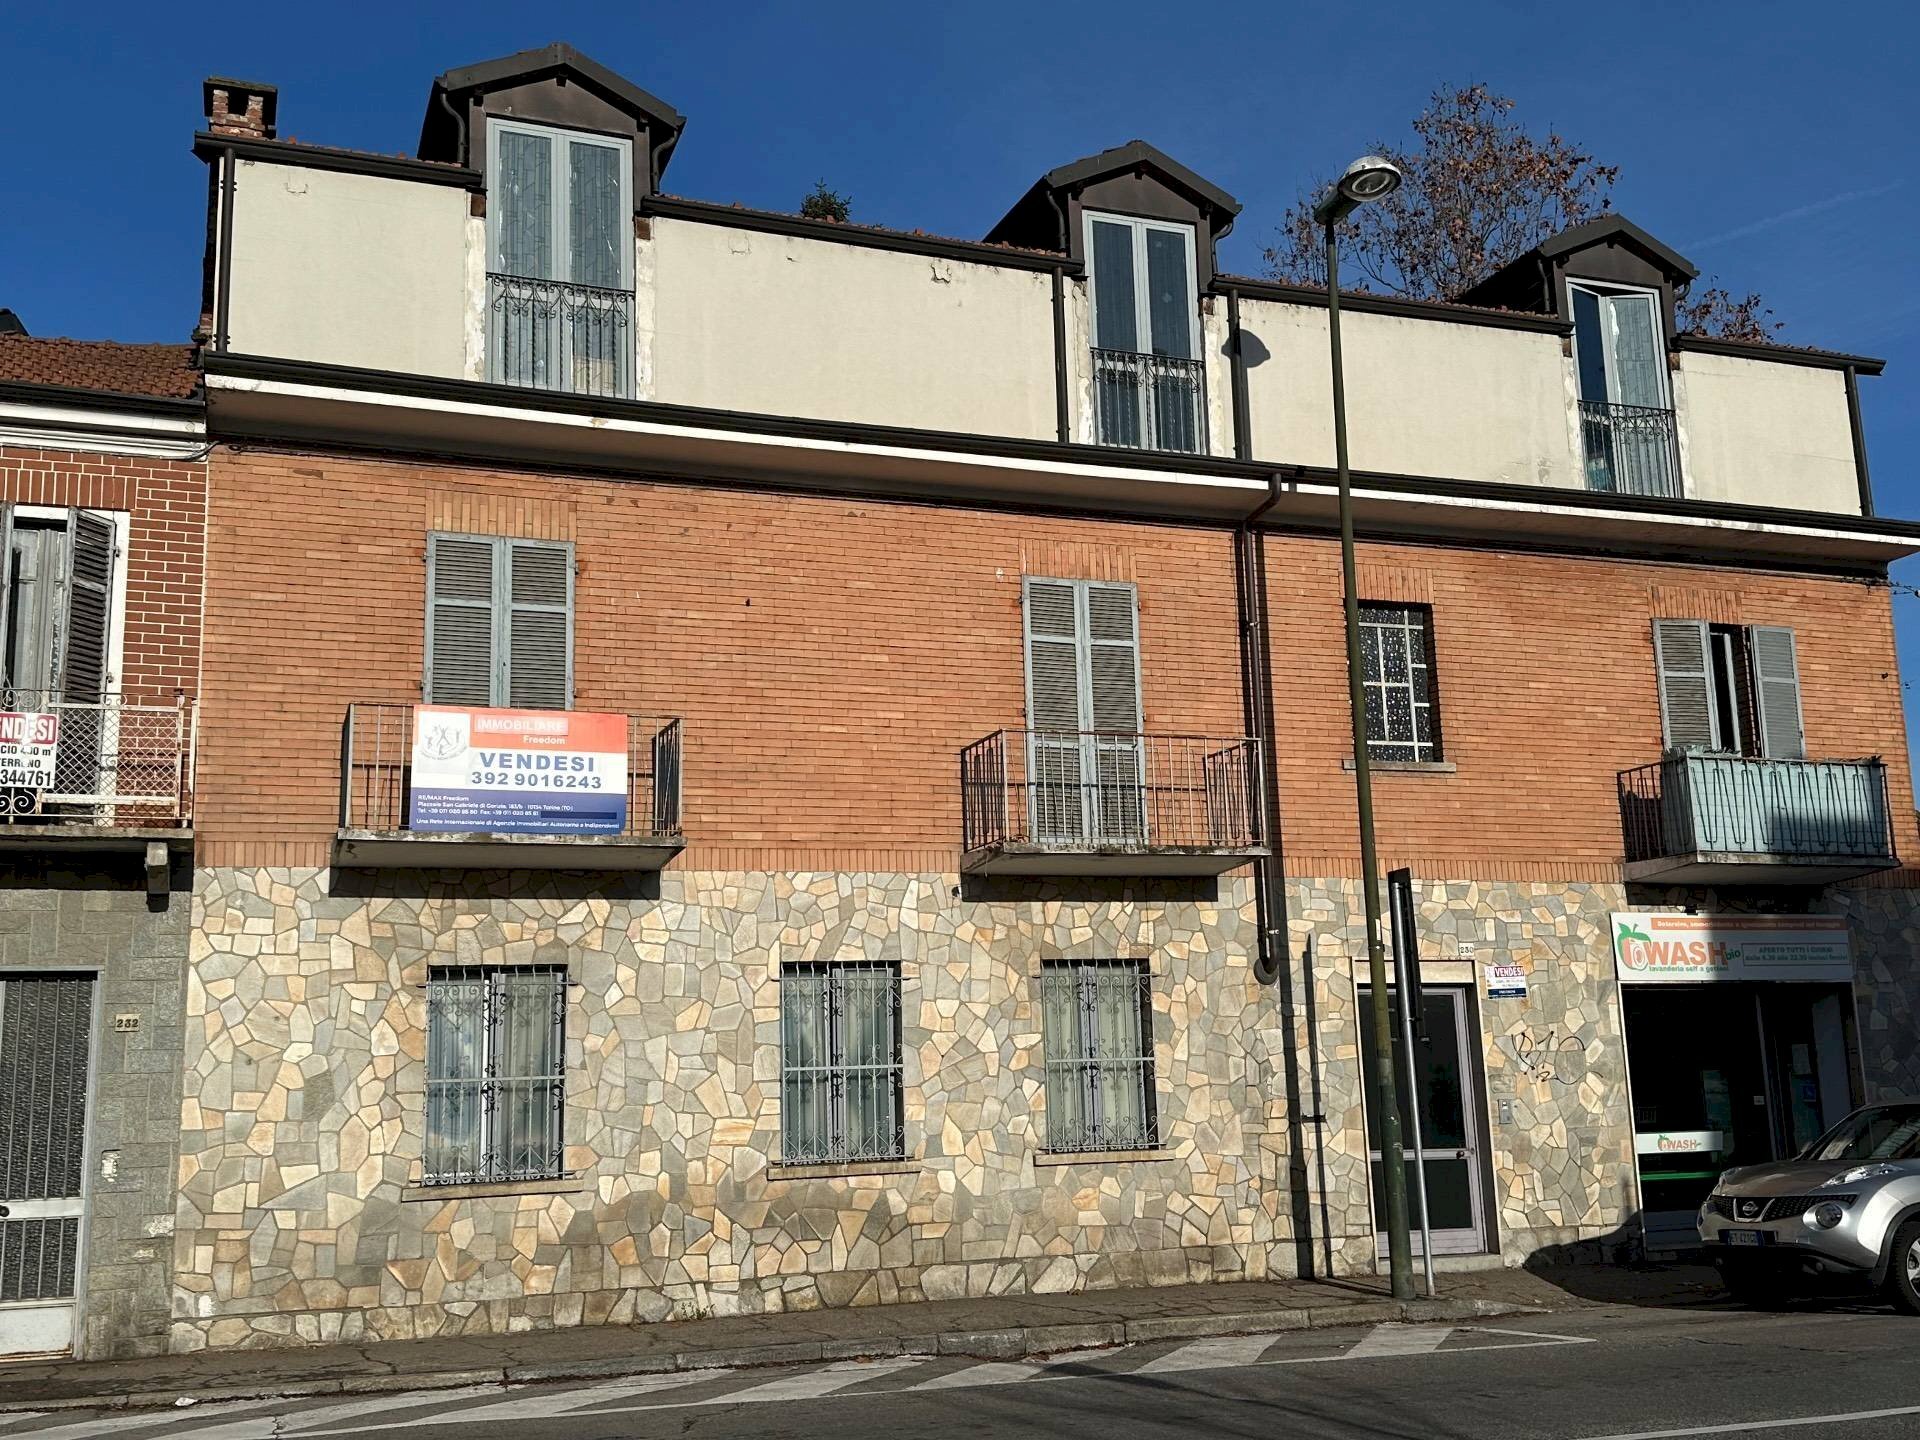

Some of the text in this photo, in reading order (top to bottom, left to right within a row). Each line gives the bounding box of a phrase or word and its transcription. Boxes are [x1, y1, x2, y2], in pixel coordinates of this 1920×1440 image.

[477, 718, 567, 732] IMMOBILIARE
[523, 735, 566, 745] Freedom
[480, 752, 594, 772] VENDESI
[472, 772, 602, 789] 392 9016243
[1460, 946, 1474, 954] 230
[1724, 949, 1741, 961] bio
[1495, 967, 1525, 977] VENDESI
[116, 1018, 139, 1028] 232
